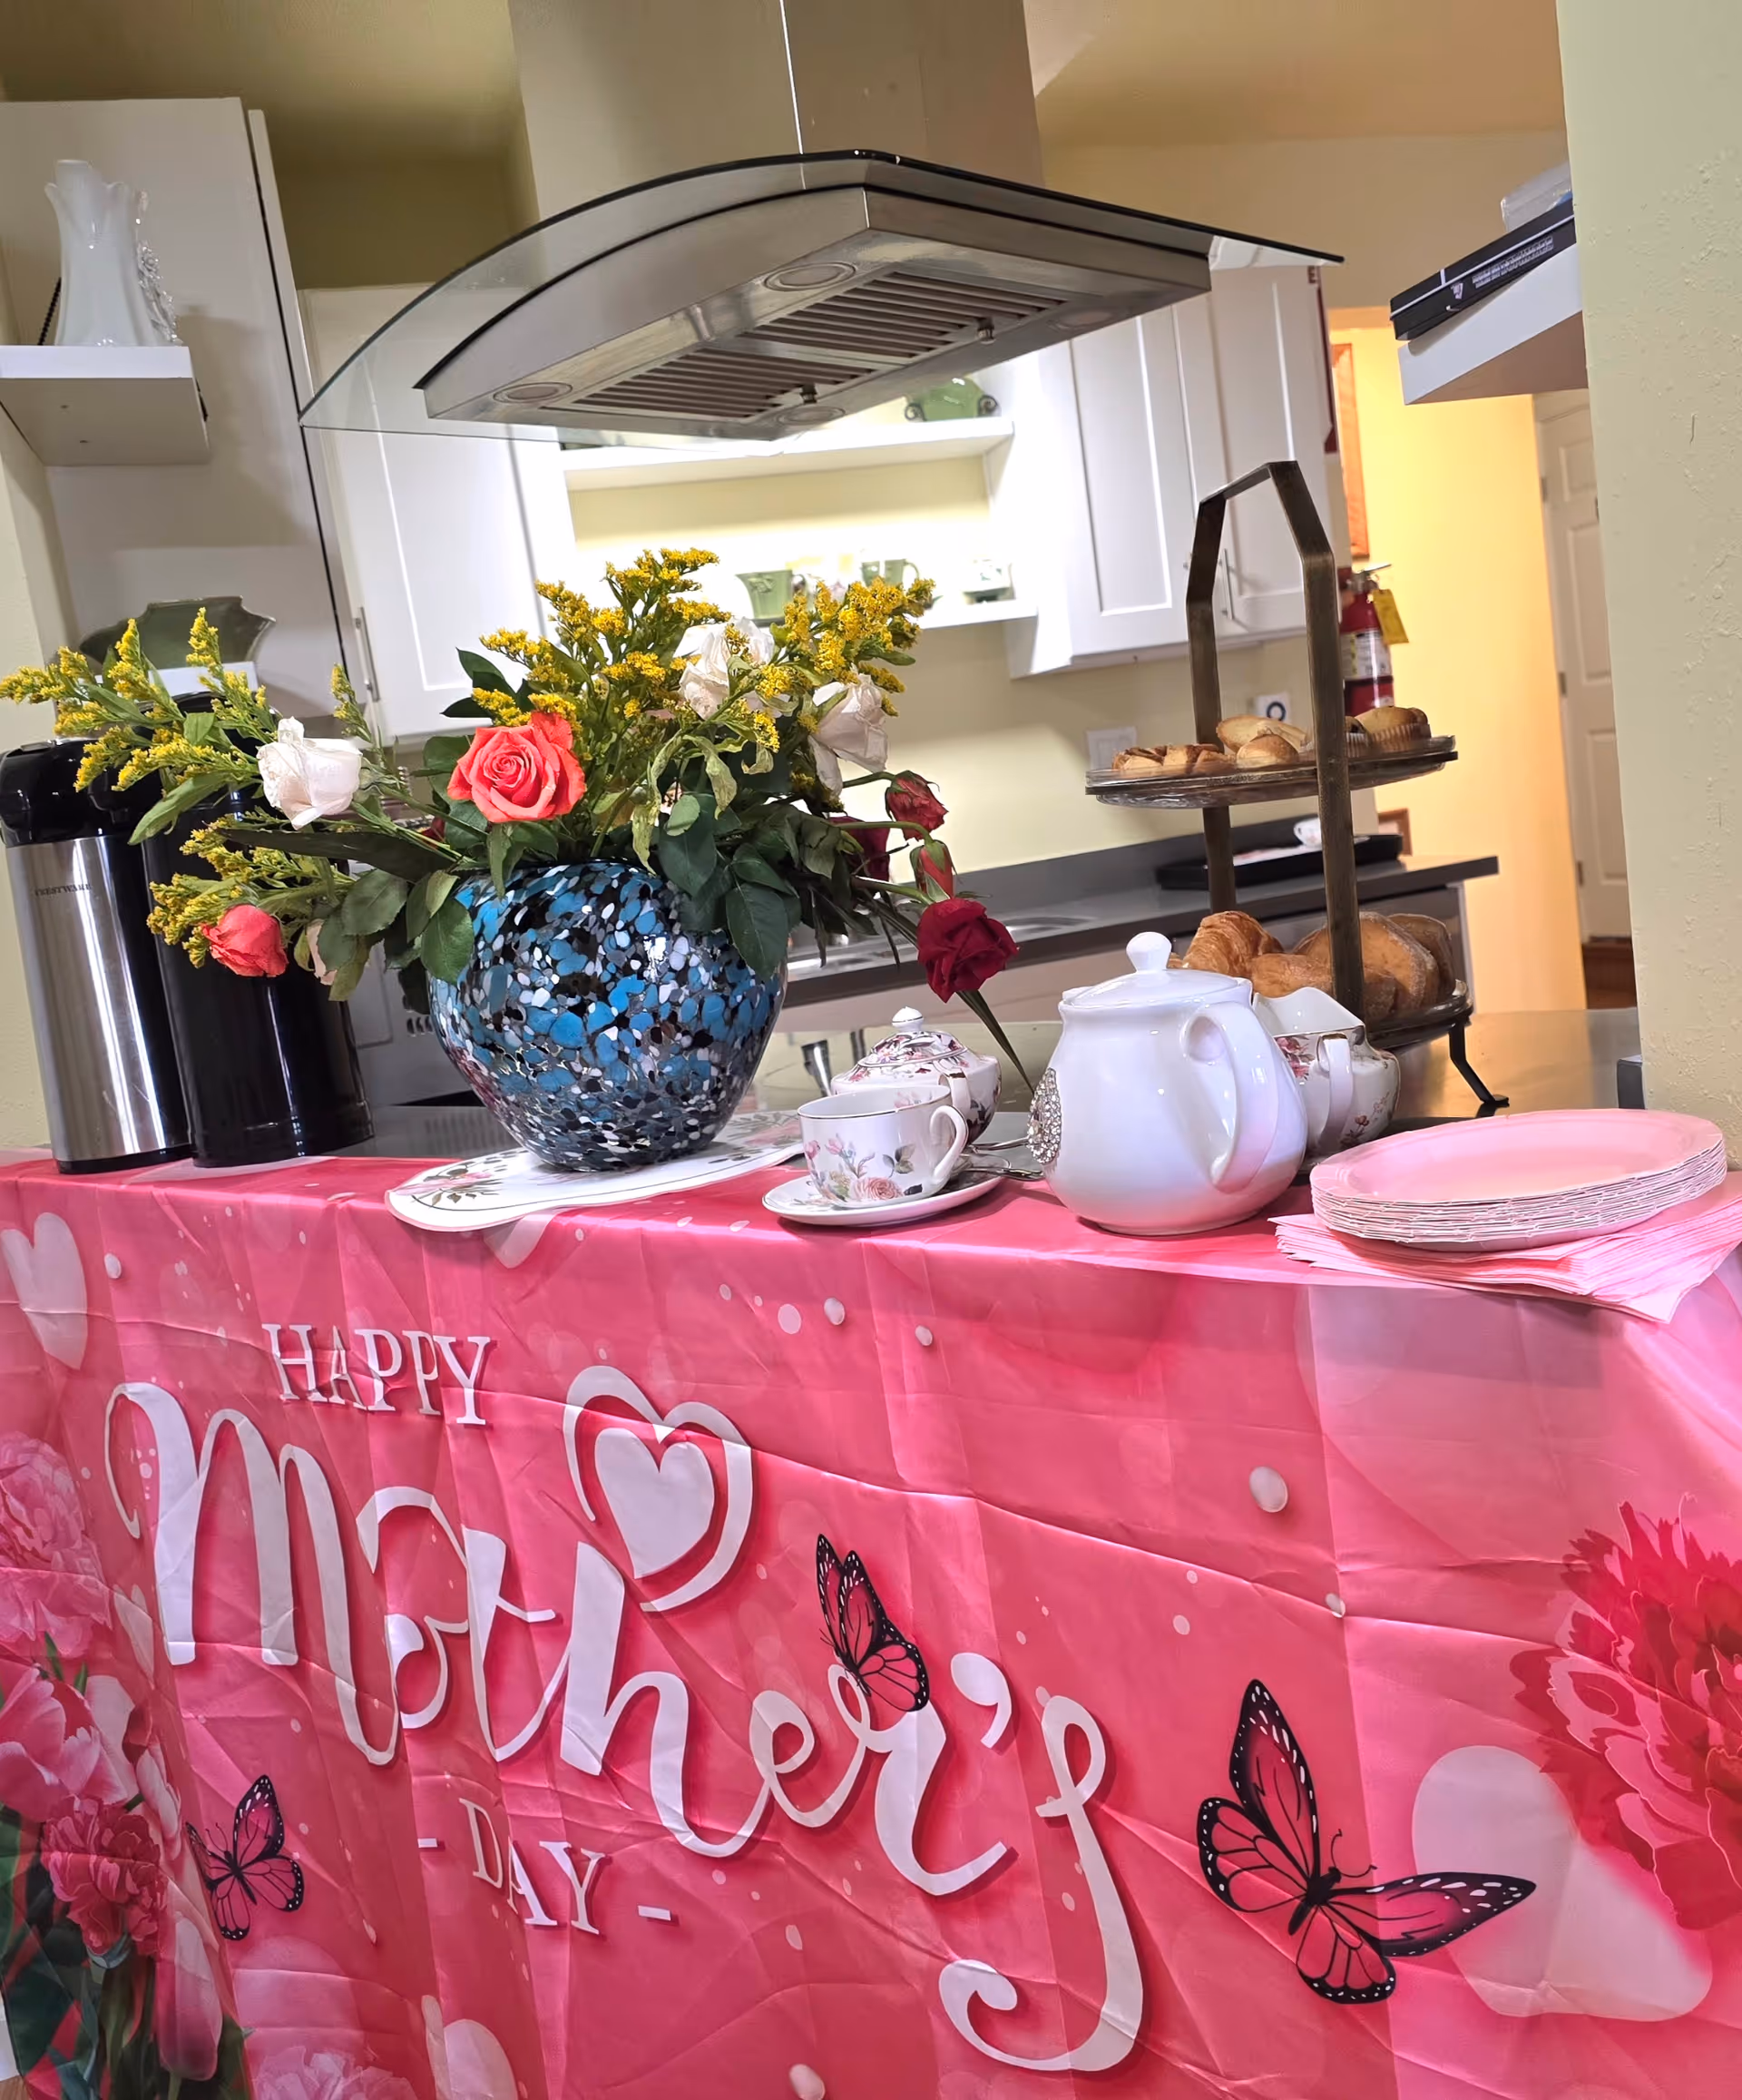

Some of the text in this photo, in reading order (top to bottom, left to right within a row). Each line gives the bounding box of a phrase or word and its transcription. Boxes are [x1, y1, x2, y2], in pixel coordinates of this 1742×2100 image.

[261, 1323, 491, 1425] HAPPY
[104, 1381, 1143, 2072] Mother's
[458, 1798, 606, 1935] DAY
